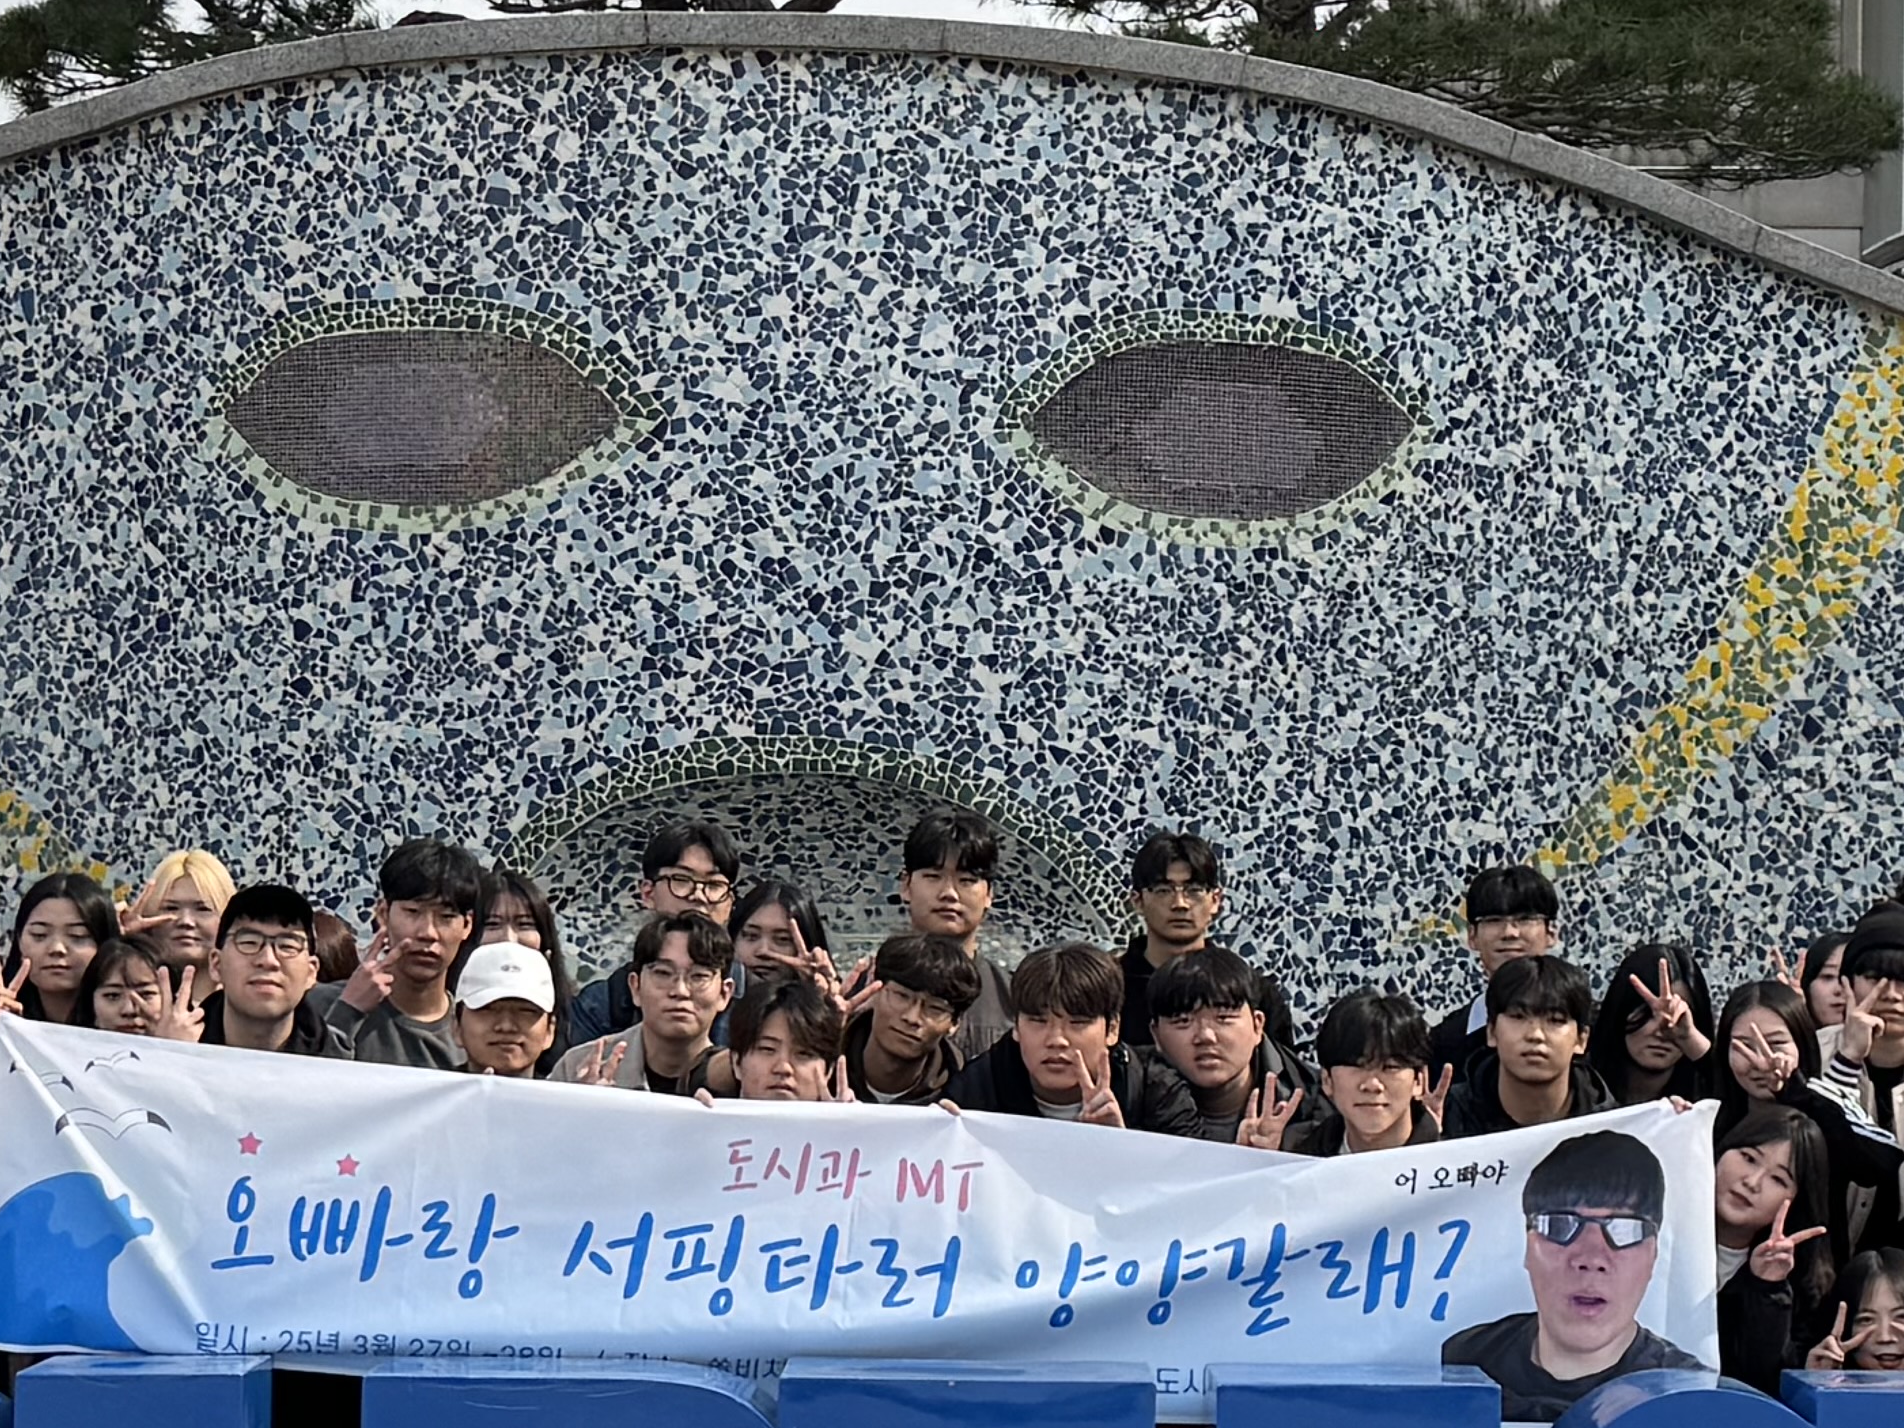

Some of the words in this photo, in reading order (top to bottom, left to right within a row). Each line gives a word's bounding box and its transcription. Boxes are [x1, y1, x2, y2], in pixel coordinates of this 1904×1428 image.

[721, 1138, 871, 1201] 도시과
[896, 1155, 985, 1212] MT
[1394, 1167, 1418, 1195] 어
[1427, 1159, 1510, 1190] 오빠야
[210, 1173, 519, 1300] 오빠랑
[562, 1211, 962, 1318] 서핑타러
[1014, 1218, 1472, 1338] 양양갈래?
[196, 1322, 248, 1355] 일시
[277, 1330, 340, 1355] 25년
